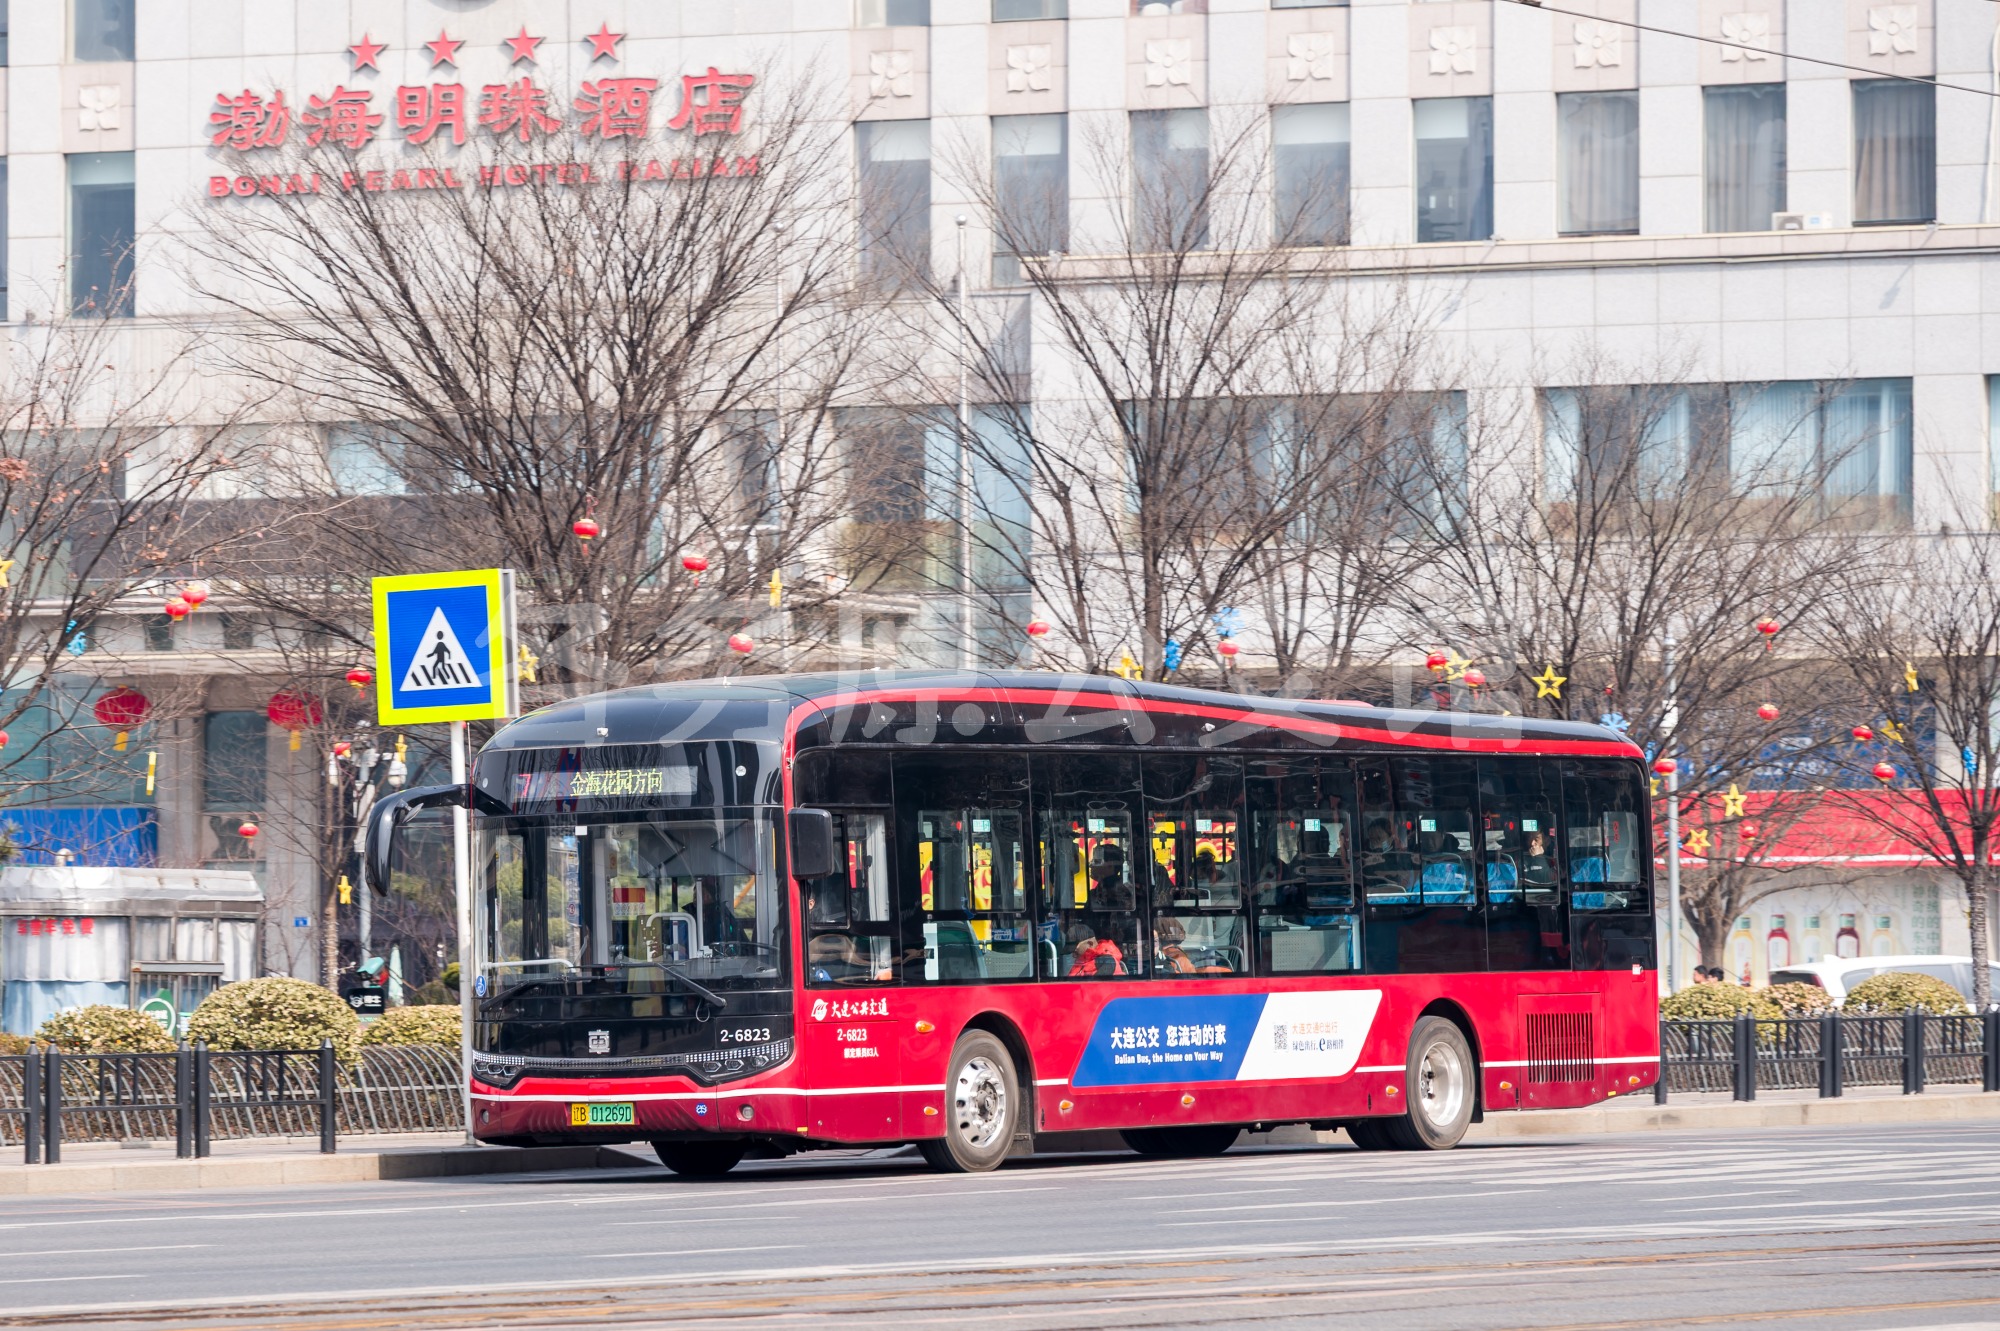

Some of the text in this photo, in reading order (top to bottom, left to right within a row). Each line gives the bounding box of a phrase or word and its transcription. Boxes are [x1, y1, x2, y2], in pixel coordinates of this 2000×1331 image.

[209, 67, 753, 150] 渤海明珠酒店
[208, 155, 761, 198] BOHAI PEARL HOTEL DALIAN
[571, 768, 663, 797] 金海花园方向
[719, 1027, 771, 1042] 2-6823
[836, 1028, 867, 1041] 2-6823
[1110, 1023, 1227, 1049] 大连公交 您流动的家
[1114, 1050, 1224, 1065] Dalian Bus, the Home on Your Way
[591, 1104, 632, 1121] 01269D
